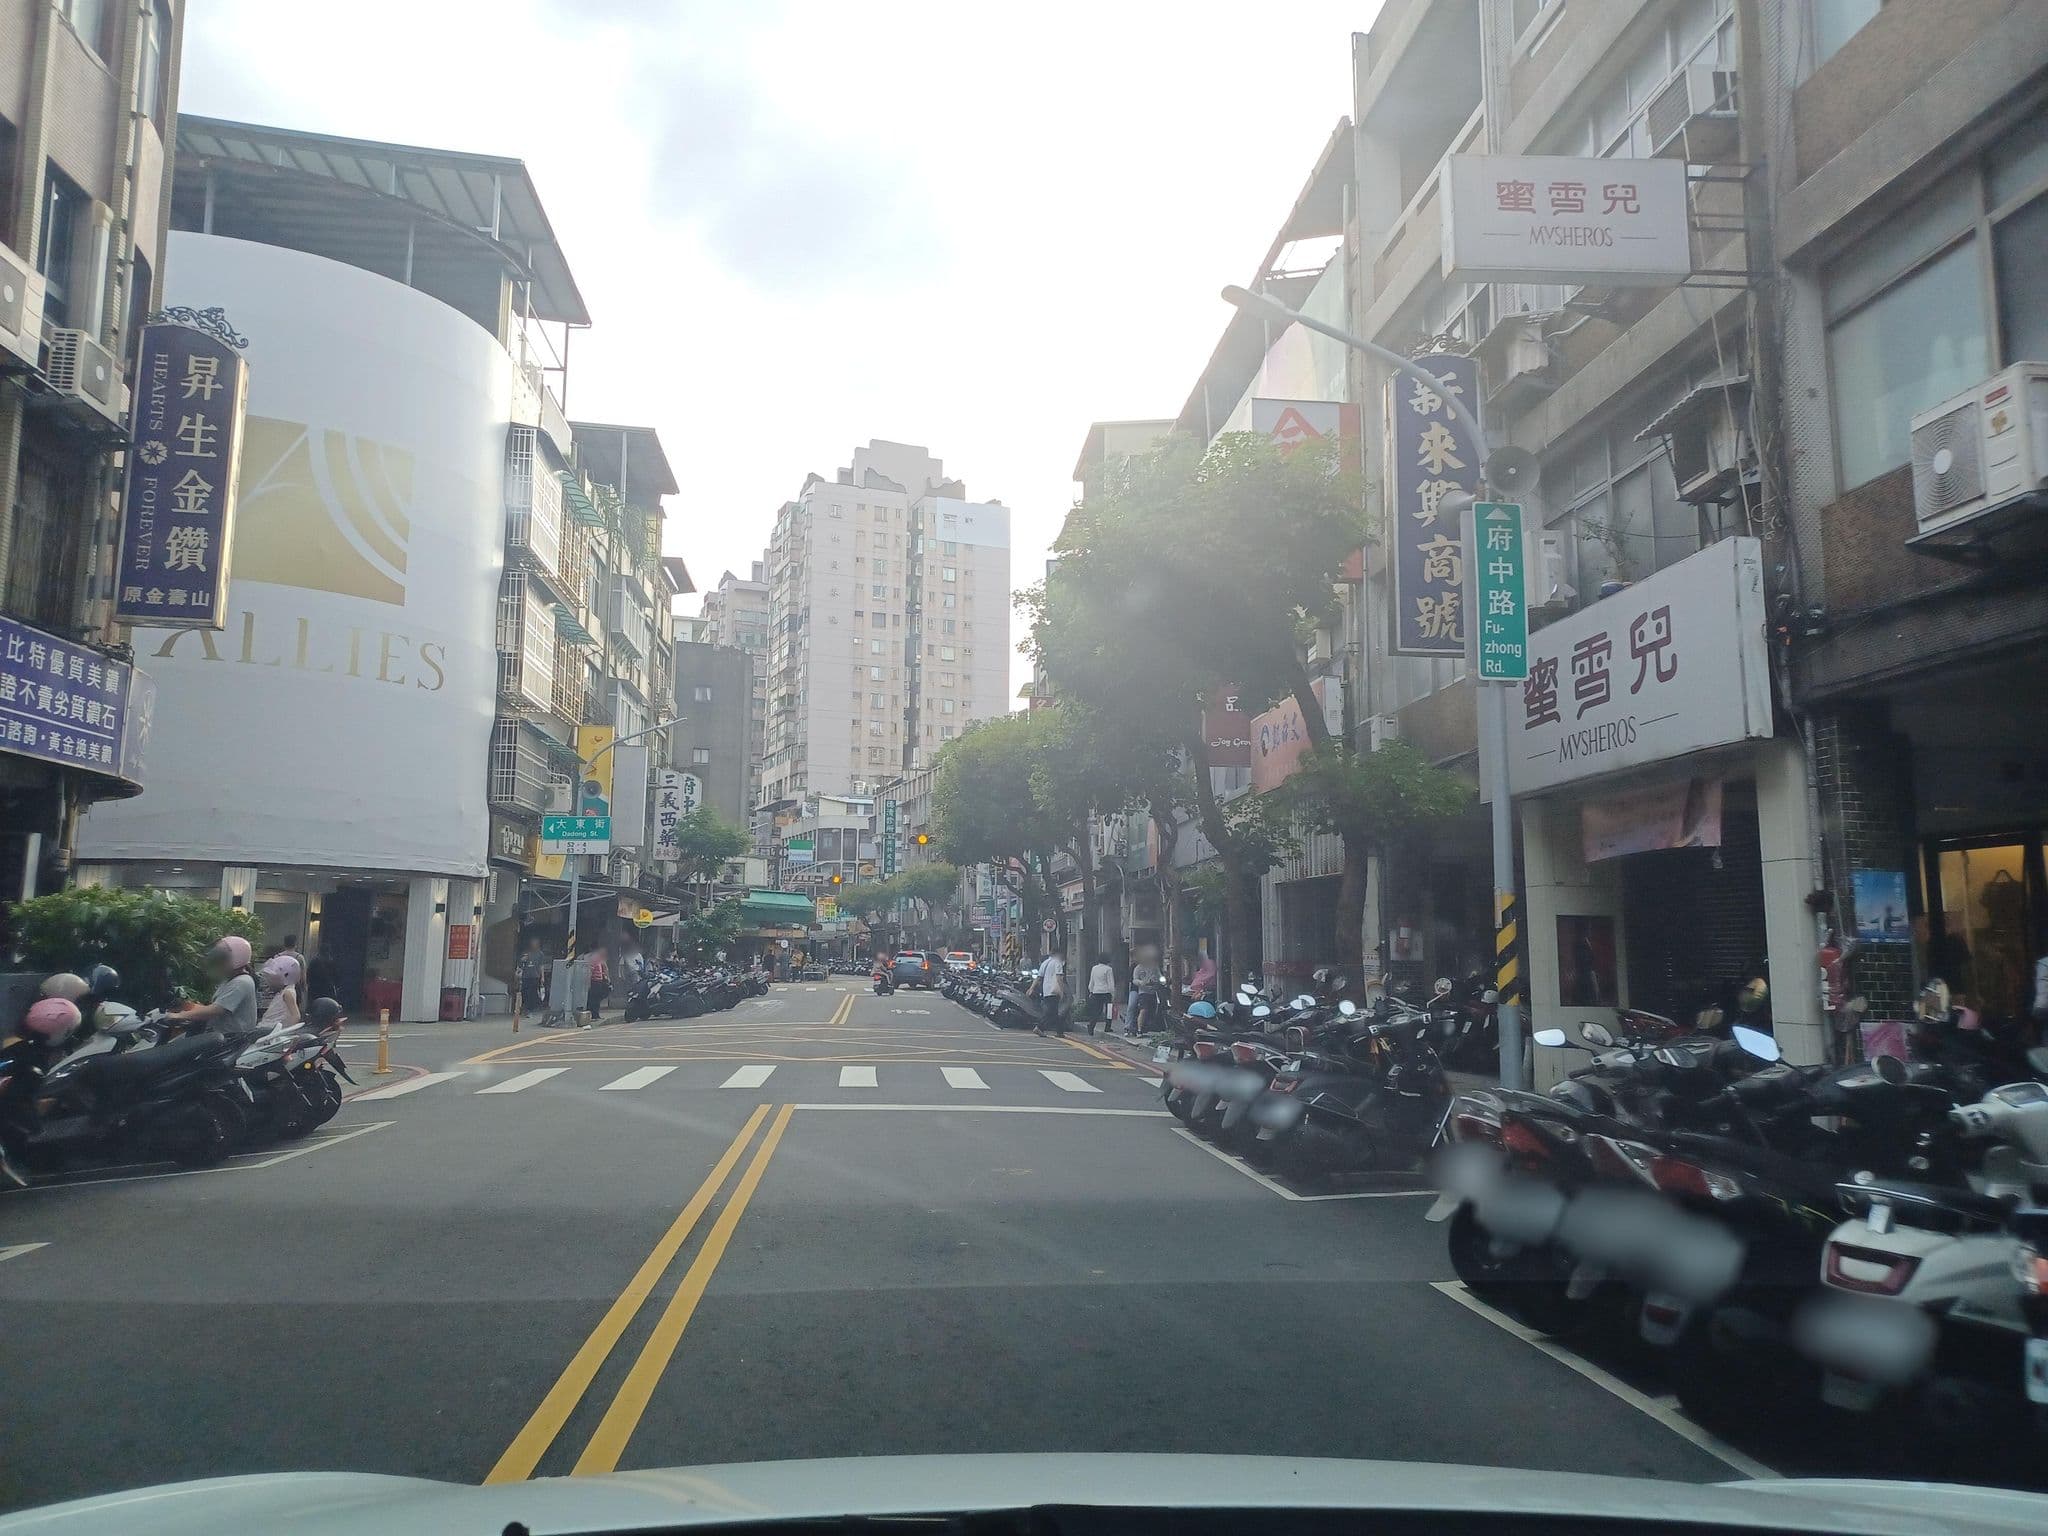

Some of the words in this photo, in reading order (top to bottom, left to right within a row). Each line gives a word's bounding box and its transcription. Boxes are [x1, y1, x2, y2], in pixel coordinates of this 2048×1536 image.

[1496, 179, 1641, 216] 蜜雪兒
[1529, 226, 1614, 247] MYSHEROS
[149, 353, 169, 431] HEARTS
[165, 352, 224, 573] 昇生金鑽
[135, 477, 158, 571] FOREVER
[1486, 525, 1516, 617] 府中路
[123, 586, 210, 607] 原金壽山
[1485, 620, 1505, 634] Fu-
[151, 611, 446, 691] ALLIES
[1485, 640, 1522, 658] zhong
[1486, 659, 1505, 673] Rd.
[1523, 604, 1678, 731] 蜜雪兒
[1558, 715, 1637, 763] MYSHEROS
[556, 819, 605, 830] 大東街
[562, 830, 587, 838] Dadong
